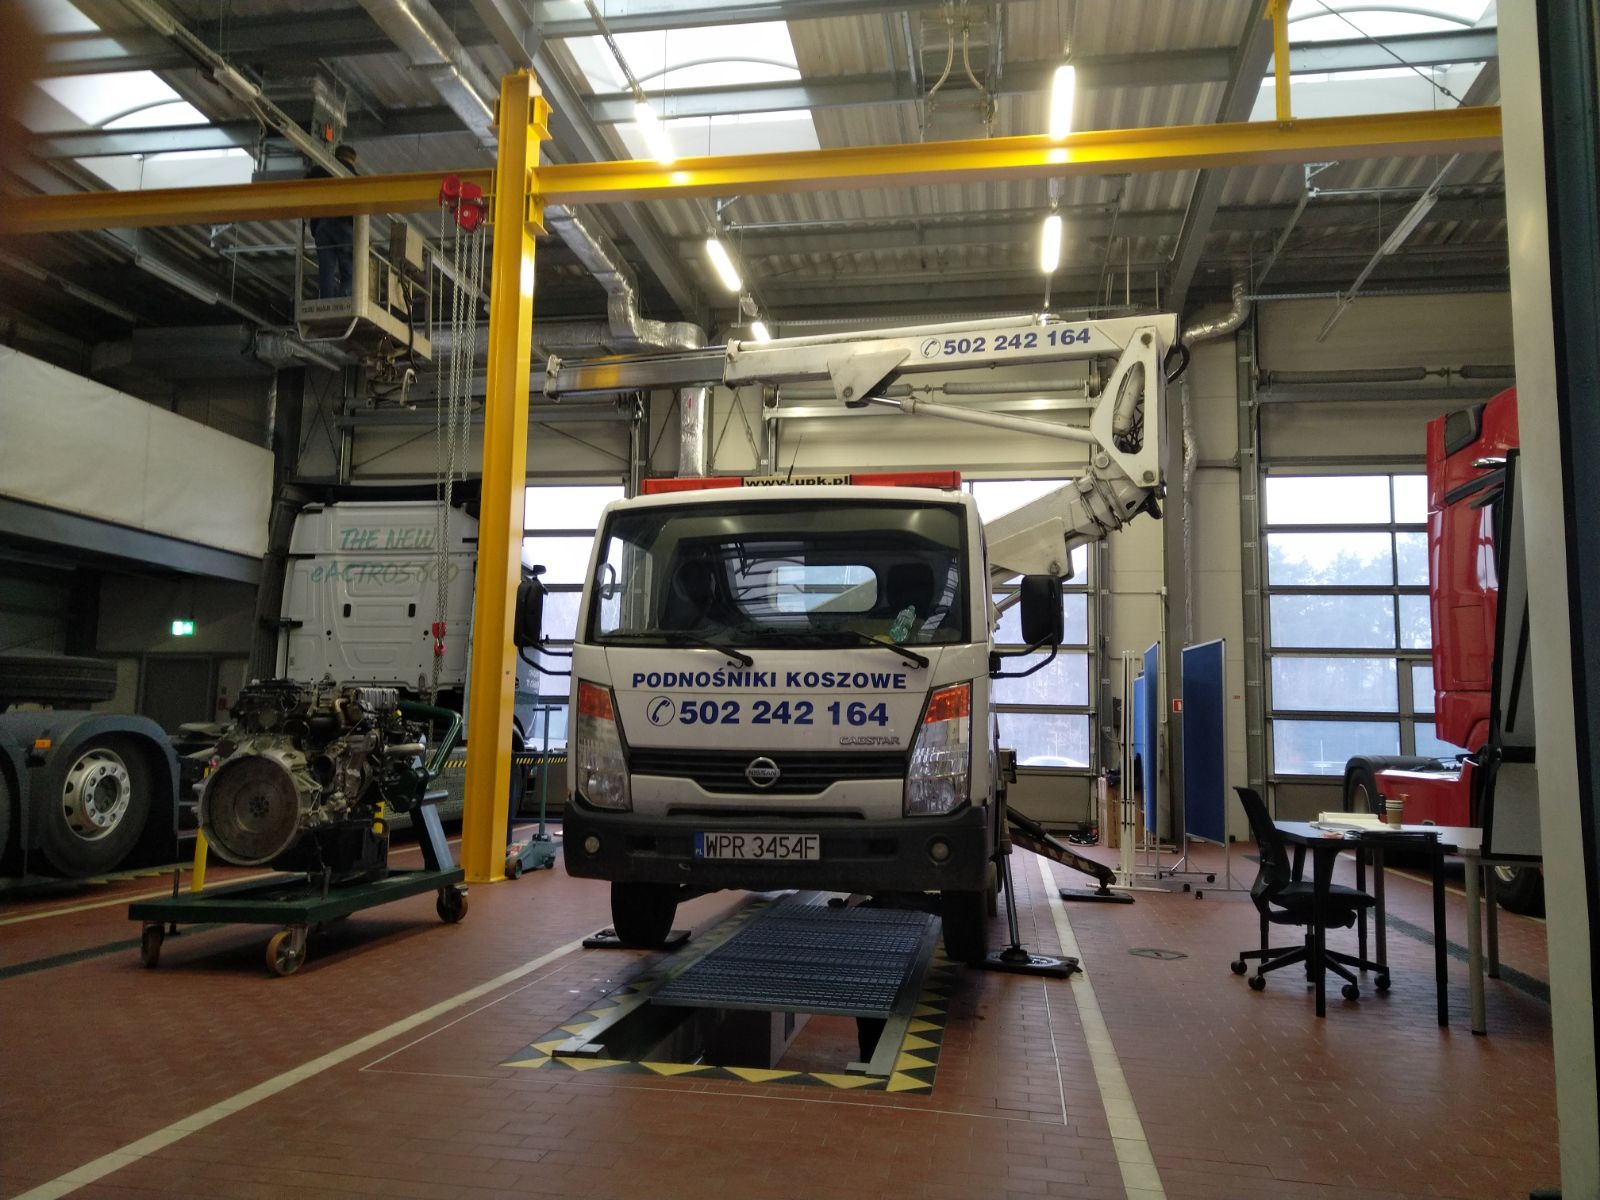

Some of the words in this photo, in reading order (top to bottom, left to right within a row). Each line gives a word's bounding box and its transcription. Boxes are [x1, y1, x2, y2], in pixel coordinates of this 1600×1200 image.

[943, 337, 986, 355] 502
[994, 332, 1037, 350] 242
[1048, 328, 1091, 346] 164
[340, 528, 379, 549] THE
[384, 528, 438, 549] NEW
[632, 668, 777, 688] PODNOŚNIKI
[786, 672, 907, 689] KOSZOWE
[679, 701, 741, 724] 502
[751, 701, 814, 725] 242
[827, 702, 889, 726] 164
[839, 735, 900, 746] CABSTAR
[706, 835, 745, 858] WPR
[752, 836, 817, 859] 3454F
